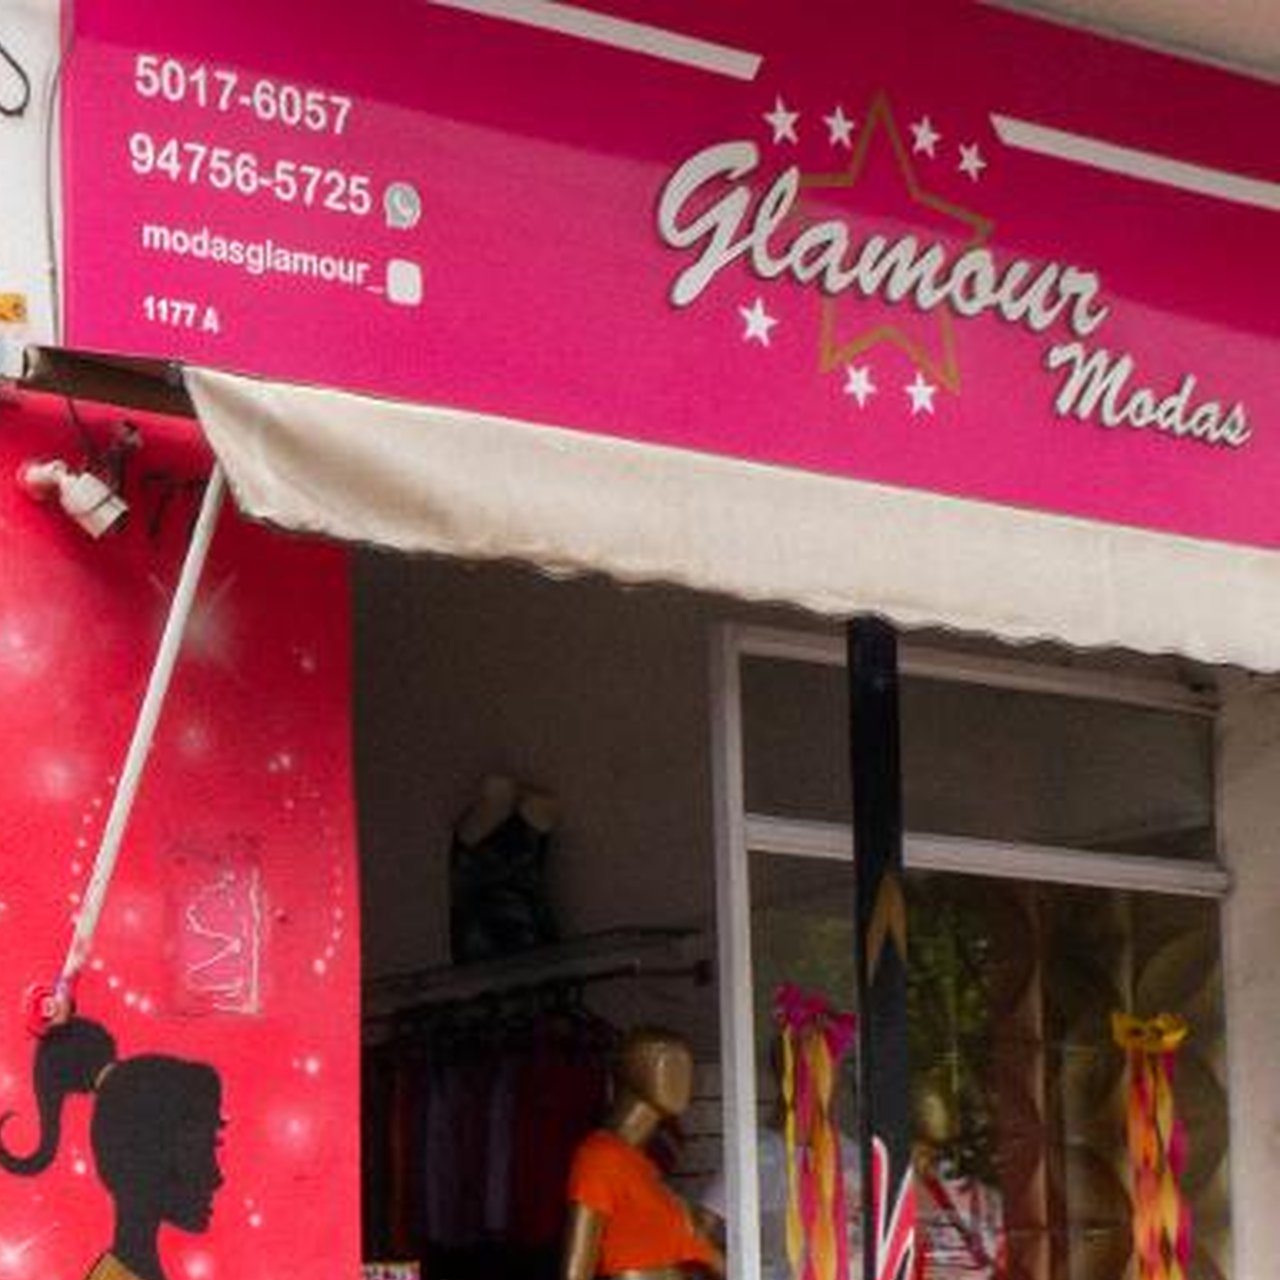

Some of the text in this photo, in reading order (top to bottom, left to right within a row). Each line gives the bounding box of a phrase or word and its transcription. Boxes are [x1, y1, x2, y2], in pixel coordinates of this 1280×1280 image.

[135, 54, 352, 135] 5017-6057
[129, 132, 372, 216] 94756-5725
[656, 140, 1109, 336] Glamour
[142, 295, 221, 334] 1177 A
[1048, 342, 1251, 448] Modas
